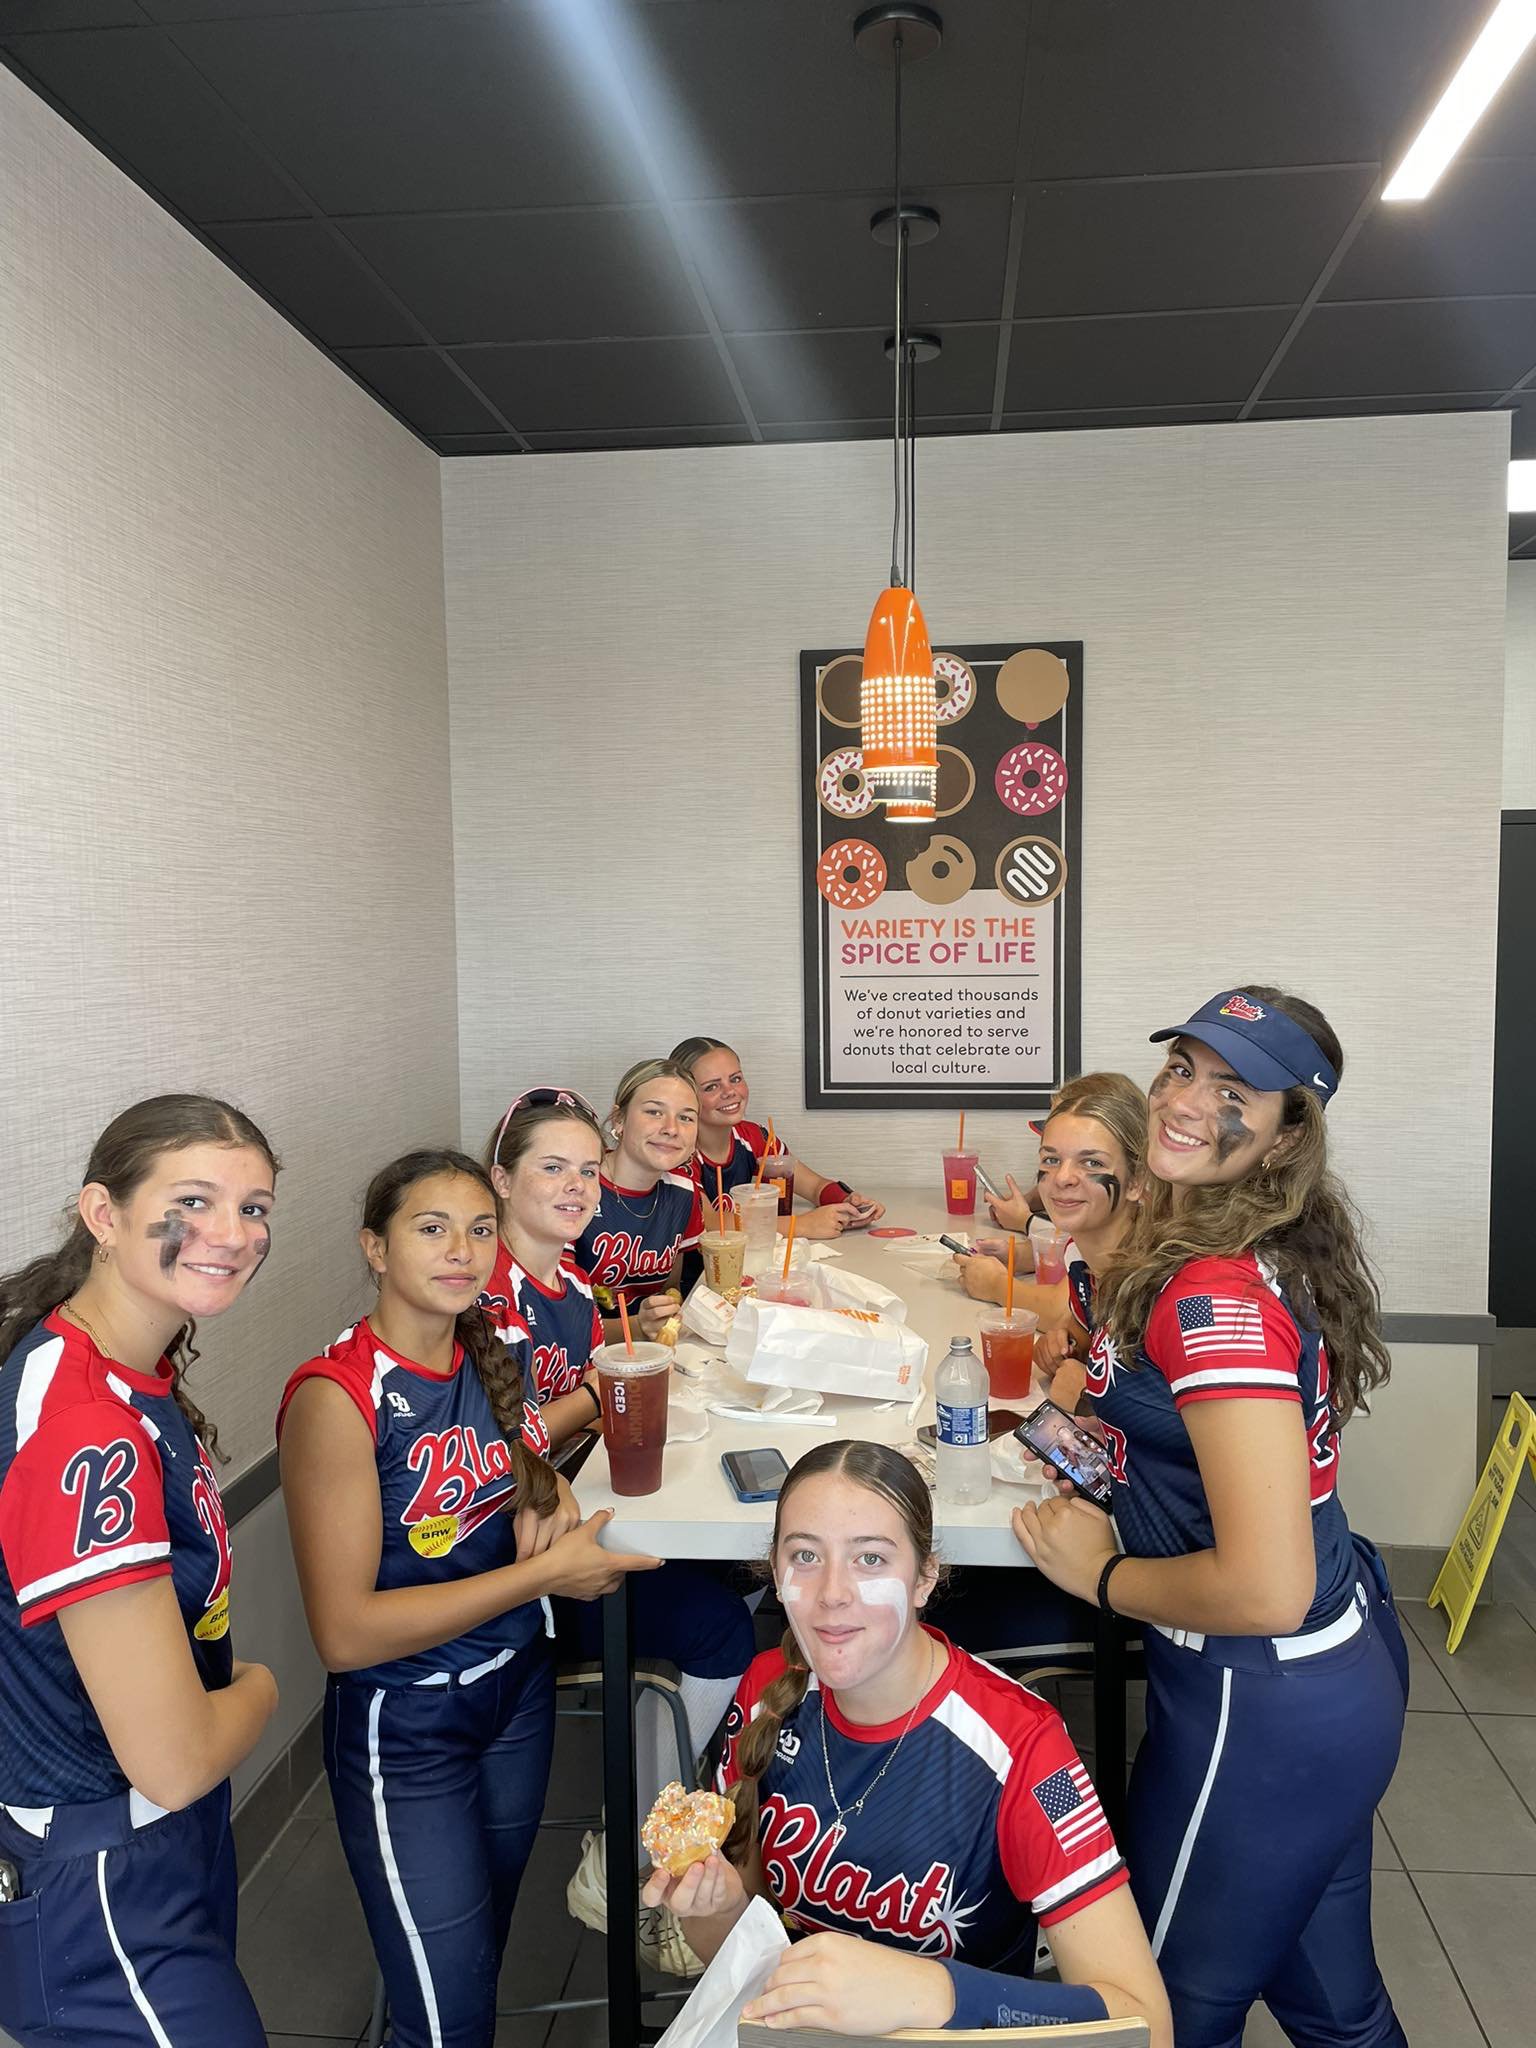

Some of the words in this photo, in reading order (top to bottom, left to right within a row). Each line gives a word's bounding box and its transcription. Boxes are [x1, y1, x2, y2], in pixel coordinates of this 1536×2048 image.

[840, 919, 946, 939] VARIETY
[954, 918, 976, 939] IS
[984, 917, 1036, 938] THE
[840, 942, 921, 965] SPICE
[928, 942, 969, 964] OF
[977, 941, 1036, 964] LIFE
[843, 989, 888, 1002] We've
[892, 988, 953, 1002] created
[957, 987, 1039, 1001] thousands
[856, 1006, 874, 1020] of
[876, 1006, 922, 1020] donut
[925, 1006, 993, 1020] varieties
[996, 1005, 1026, 1019] and
[853, 1025, 895, 1038] we're
[898, 1024, 963, 1038] honored
[966, 1025, 984, 1038] to
[986, 1027, 1030, 1038] serve
[842, 1042, 896, 1056] donuts
[898, 1042, 933, 1056] that
[935, 1042, 1011, 1056] celebrate
[1014, 1045, 1042, 1056] our
[891, 1060, 928, 1074] local
[931, 1060, 991, 1074] culture.
[613, 1381, 627, 1415] ICED
[400, 1397, 550, 1526] Blat
[61, 1438, 138, 1559] B
[421, 1527, 451, 1540] BRW
[760, 1792, 953, 1942] Blast
